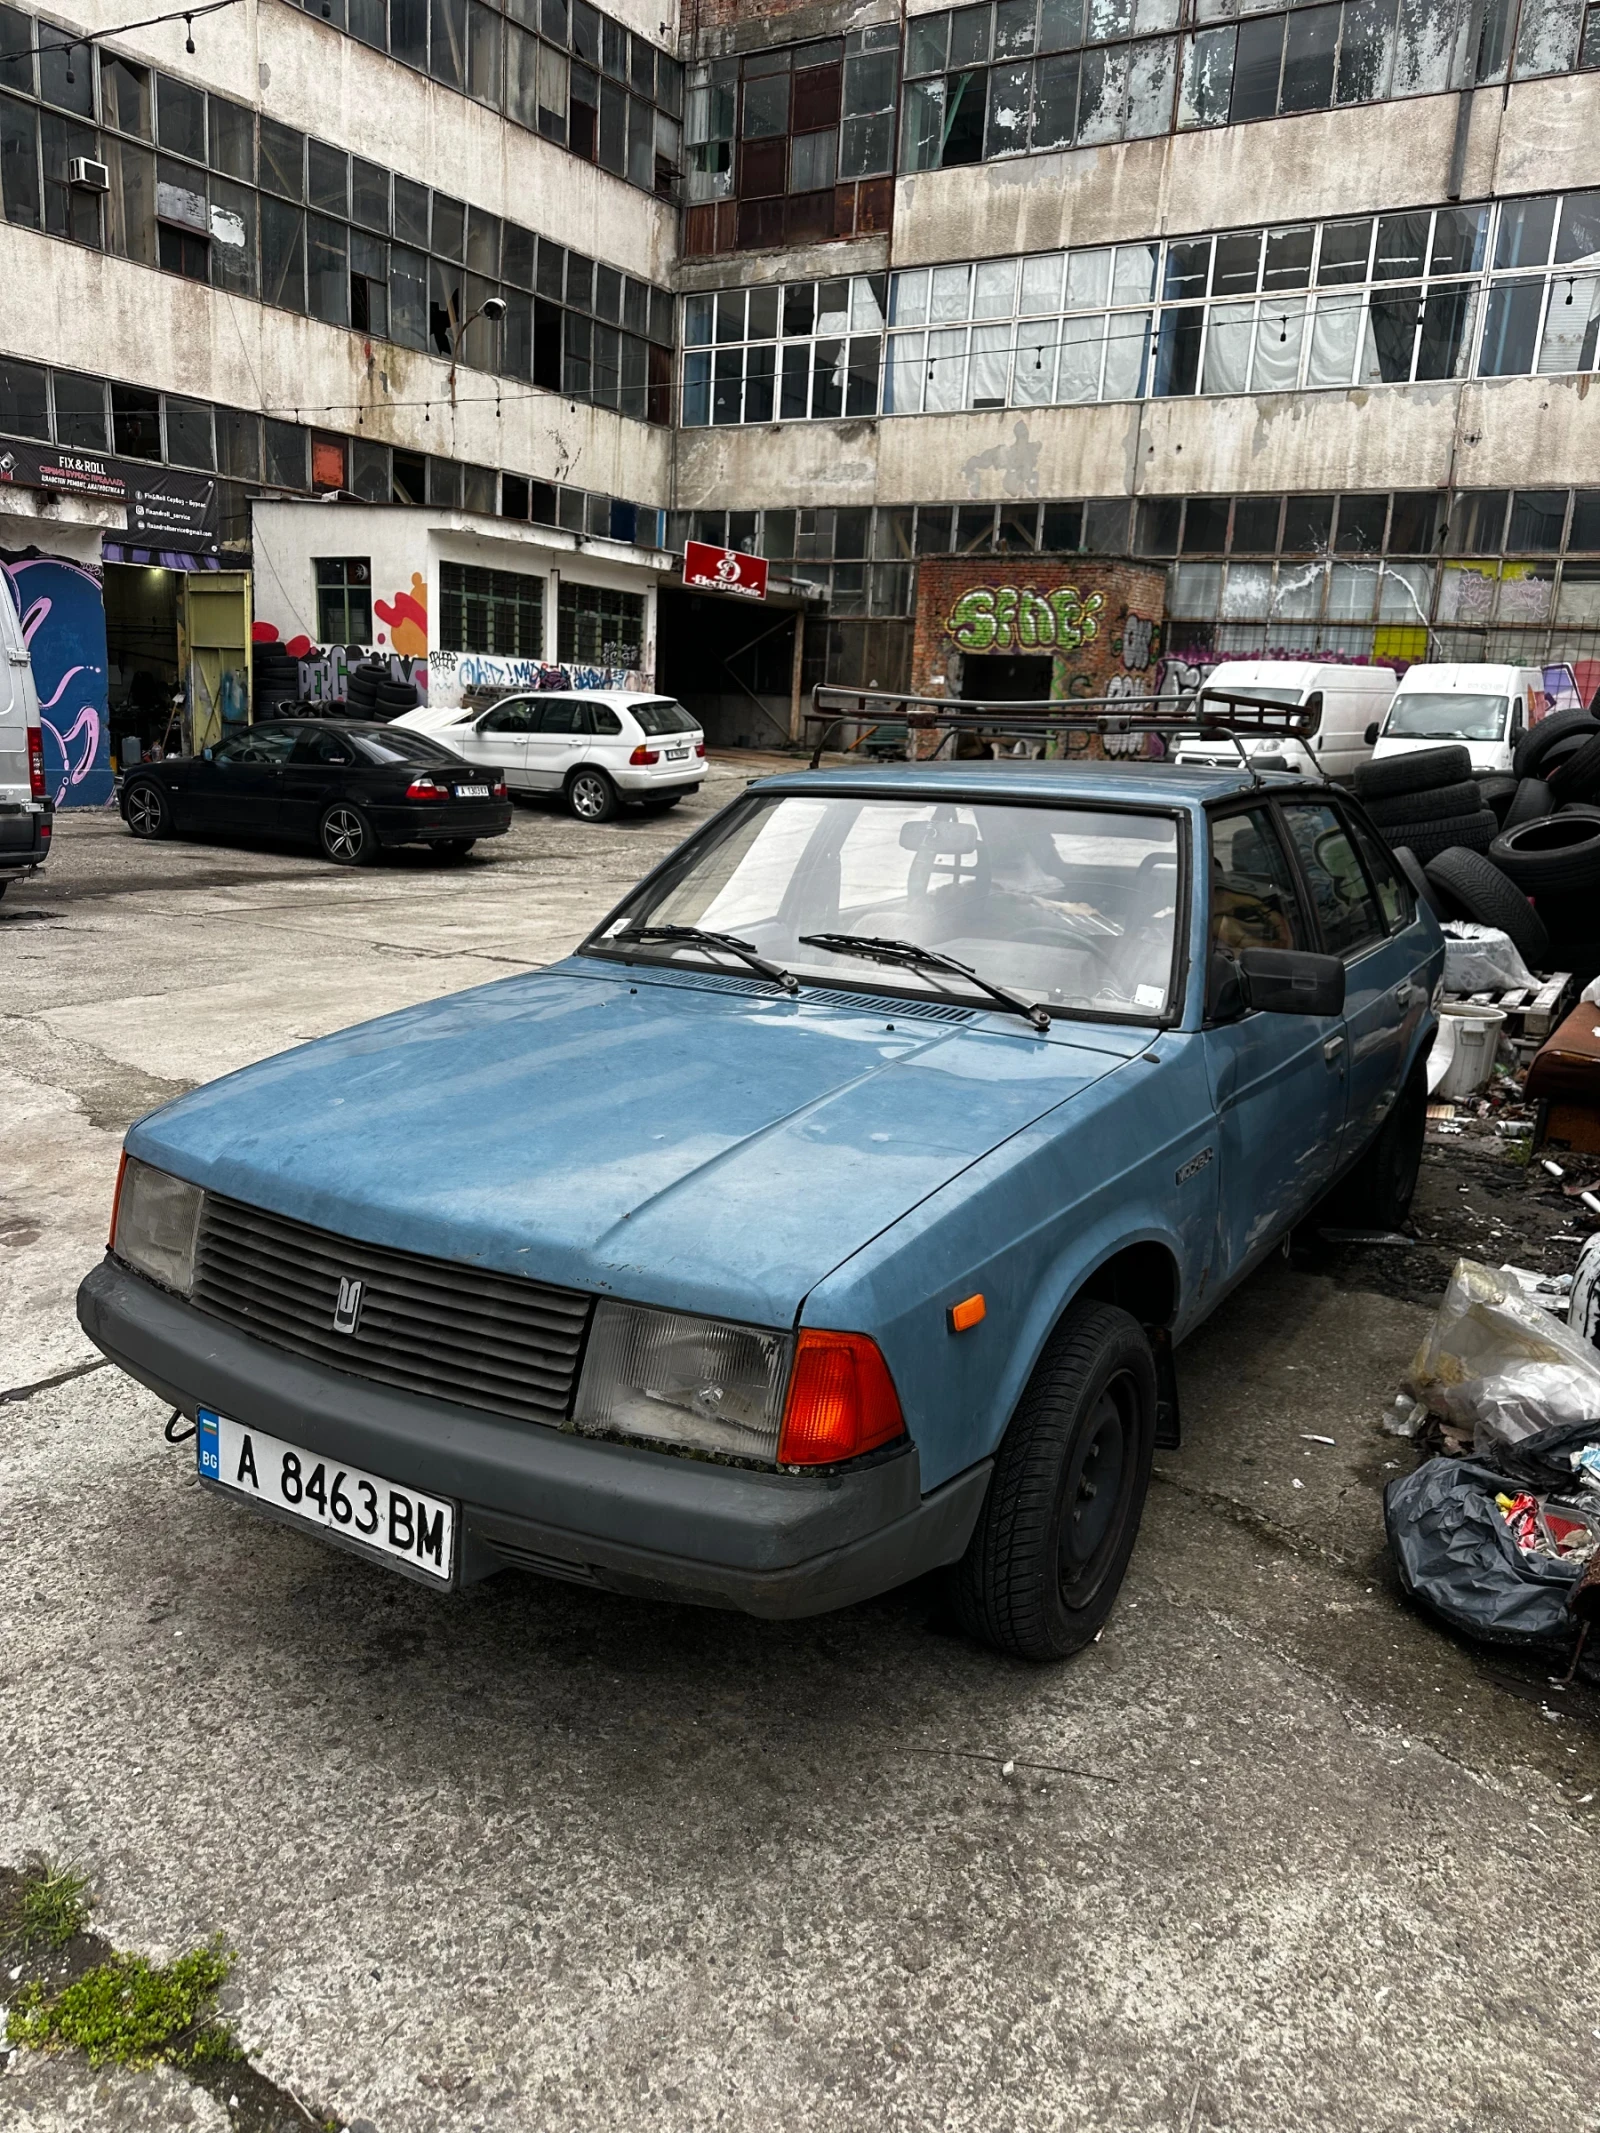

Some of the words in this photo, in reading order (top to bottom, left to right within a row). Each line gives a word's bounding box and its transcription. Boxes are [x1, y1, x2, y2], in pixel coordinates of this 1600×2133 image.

[66, 470, 90, 480] БУРГАС
[202, 1451, 218, 1469] BG
[237, 1434, 259, 1489] A
